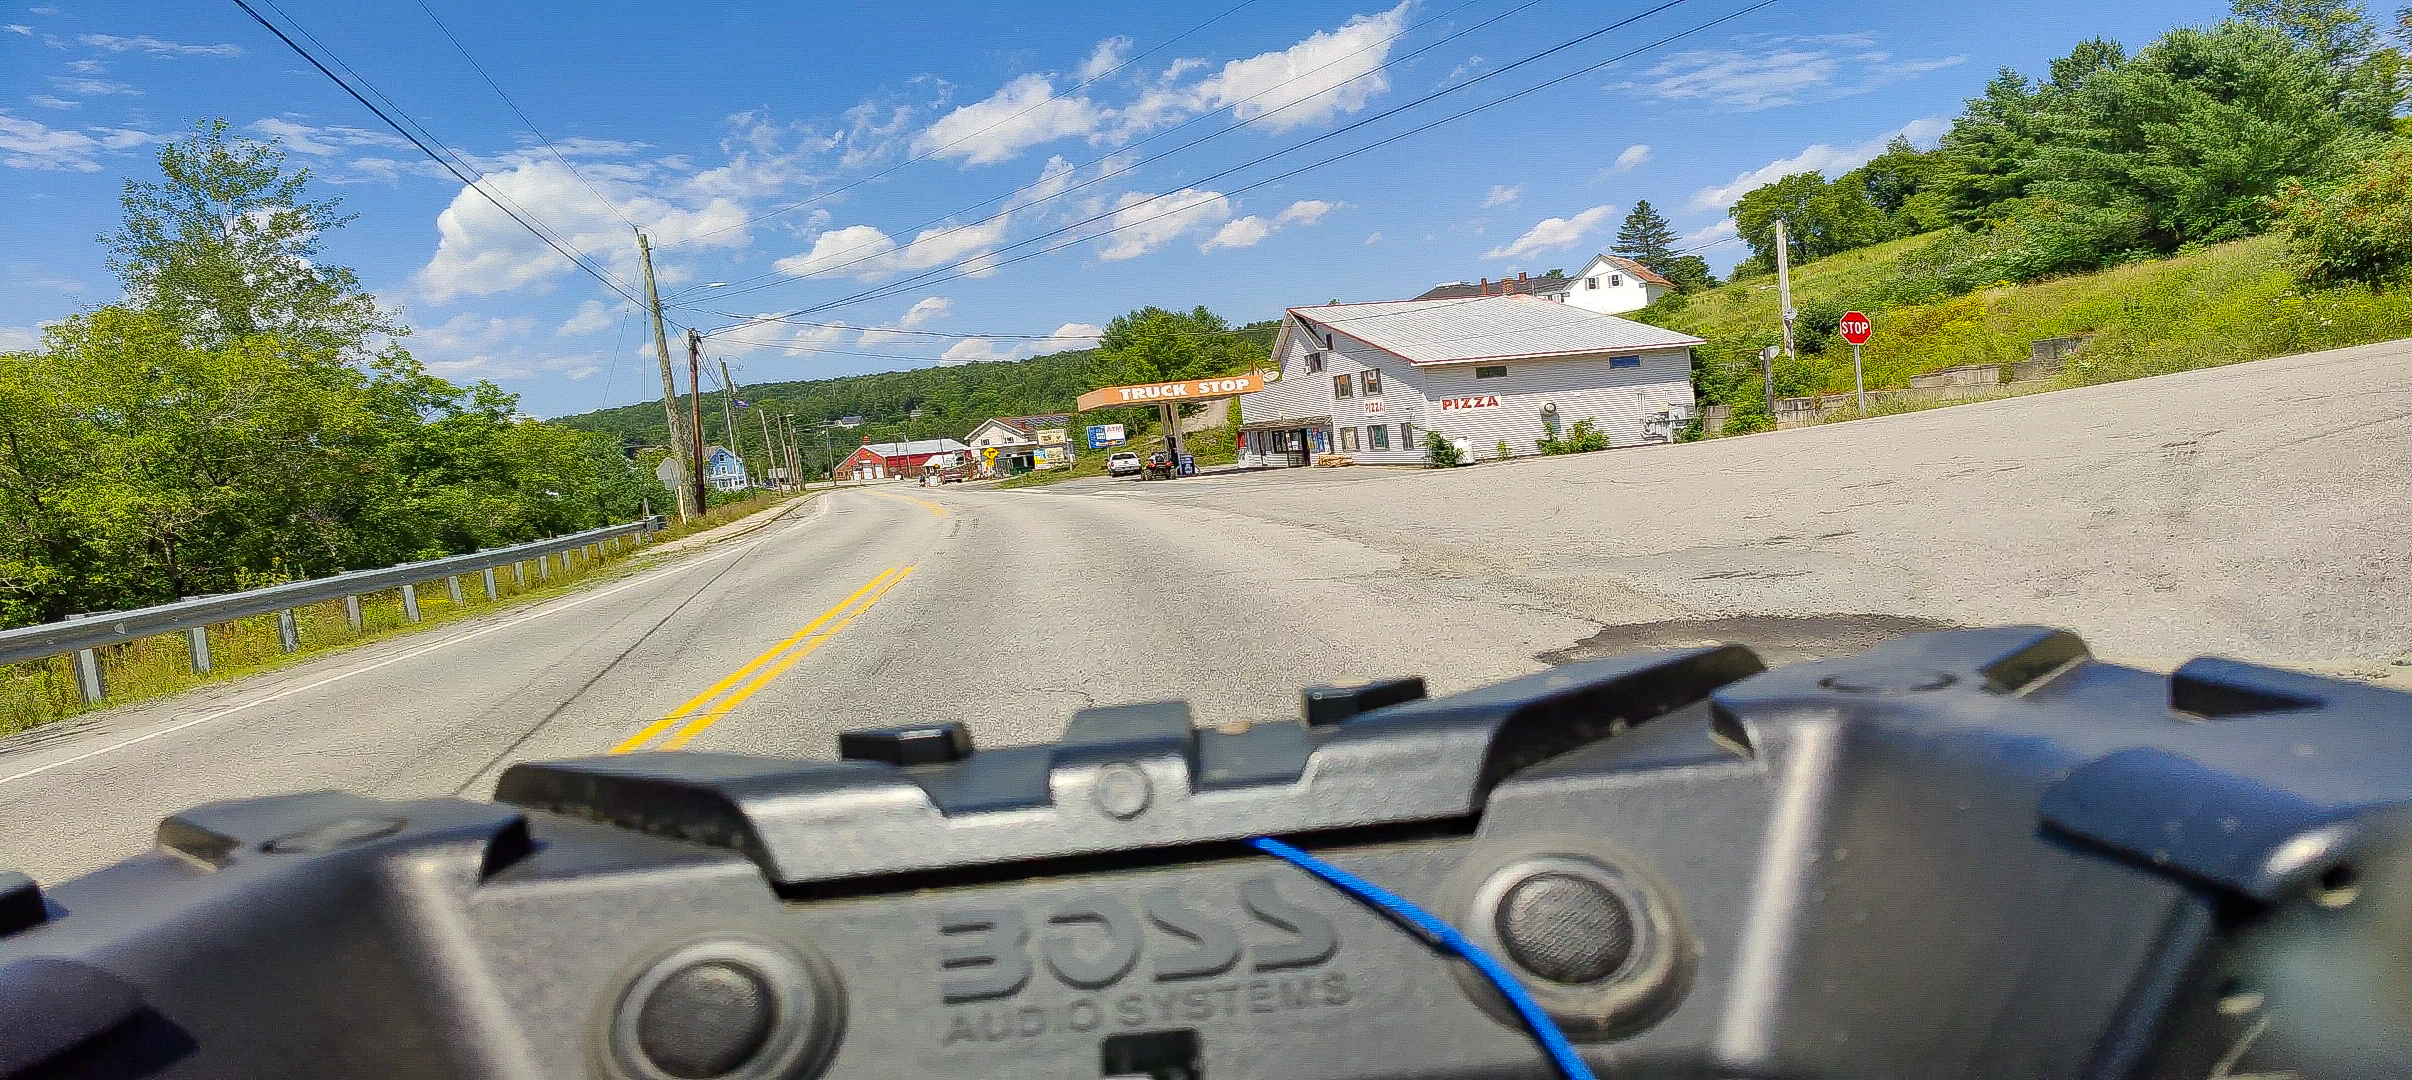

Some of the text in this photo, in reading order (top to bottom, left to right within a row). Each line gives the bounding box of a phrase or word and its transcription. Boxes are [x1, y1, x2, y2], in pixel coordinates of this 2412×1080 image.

[1841, 321, 1869, 335] STOP
[1118, 379, 1250, 401] TRUCK STOP
[1441, 395, 1499, 411] PIZZA
[937, 878, 1341, 1004] BOSS
[943, 970, 1354, 1044] AUDIO SYSTEMS
